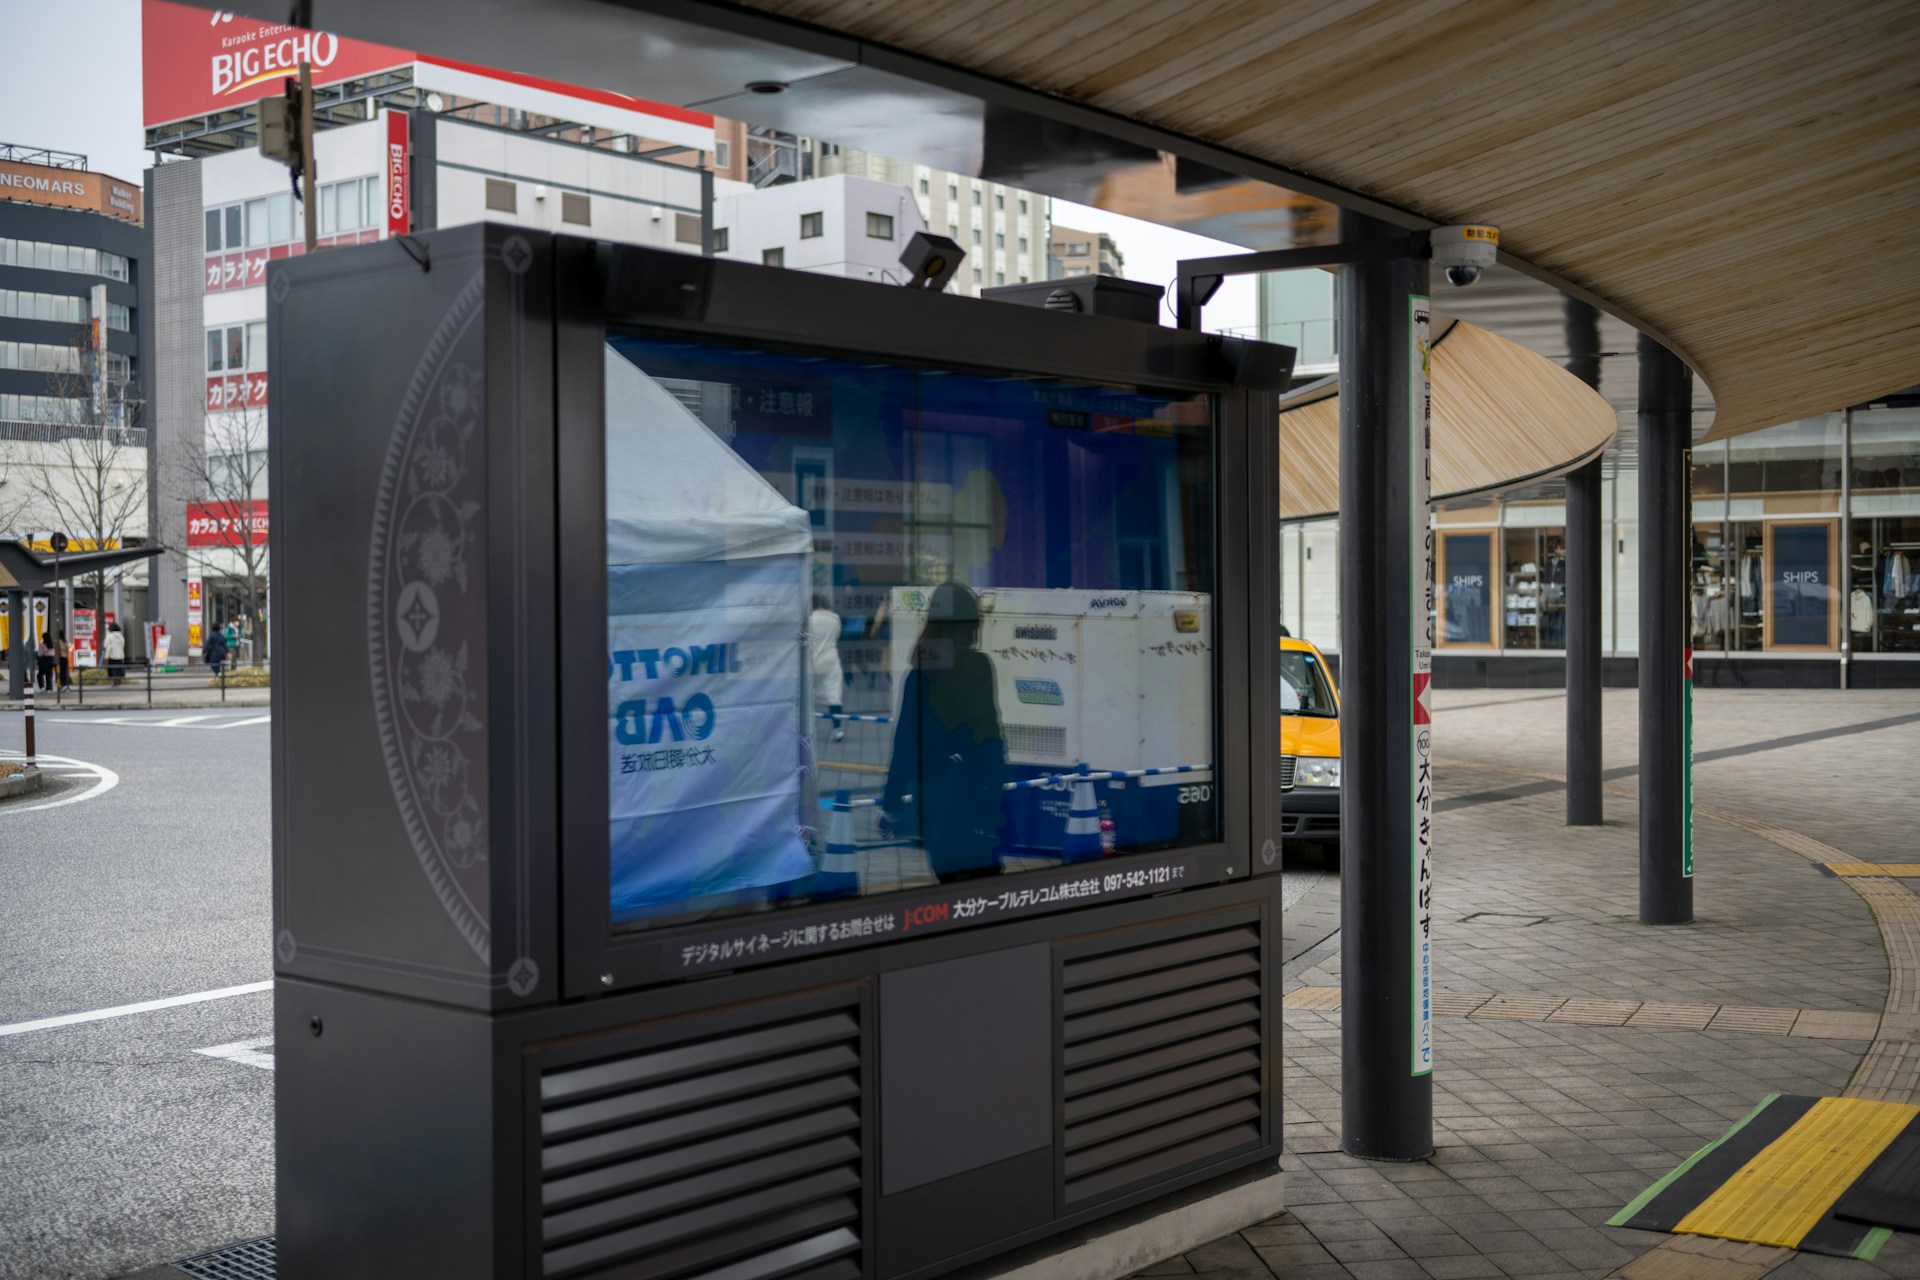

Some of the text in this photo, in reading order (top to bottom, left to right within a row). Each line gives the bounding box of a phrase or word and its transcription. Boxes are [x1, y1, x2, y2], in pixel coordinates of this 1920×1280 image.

[222, 31, 256, 48] Karaoke
[212, 31, 338, 96] BIG ECHO
[0, 173, 85, 196] NEOMARS
[390, 143, 403, 219] BIG ECHO
[207, 257, 267, 286] カラオケ
[208, 379, 267, 406] カラオケ
[1453, 574, 1483, 587] SHIPS
[1783, 571, 1819, 584] SHIPS
[682, 912, 895, 967] デジタルサイネージに関するお問合せは
[953, 877, 1100, 919] 大分ケーブルテレコム株式会社
[1103, 866, 1170, 892] 097-542-1121
